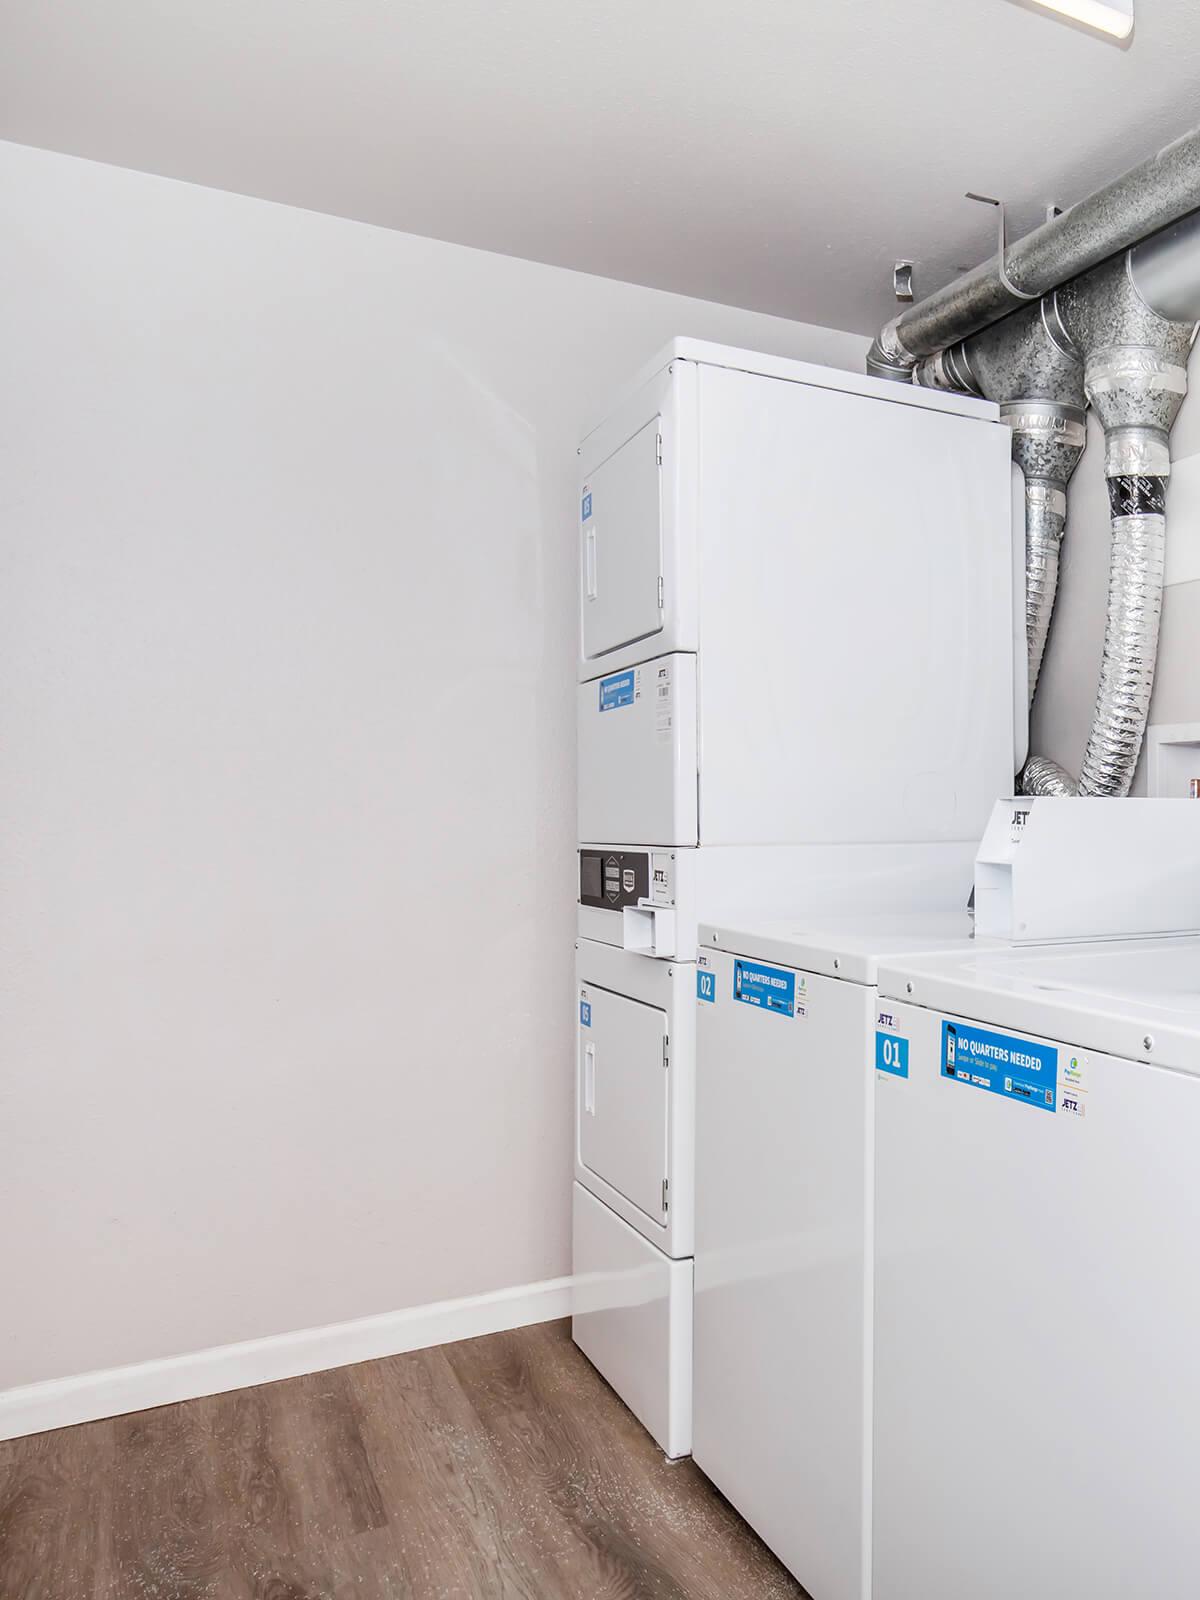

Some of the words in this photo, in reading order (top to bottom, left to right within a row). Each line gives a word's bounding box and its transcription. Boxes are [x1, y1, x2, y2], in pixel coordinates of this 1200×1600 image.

[1011, 810, 1031, 825] JET
[701, 975, 712, 996] 02
[743, 970, 749, 980] NO
[749, 972, 770, 986] QUARTERS
[770, 977, 788, 990] NEEDED
[878, 1012, 893, 1026] JETZ
[883, 1039, 901, 1068] 01
[957, 1037, 969, 1050] NO
[969, 1040, 1009, 1063] QUARTERS
[1009, 1050, 1042, 1071] NEEDED
[1062, 1098, 1078, 1112] JETZ
